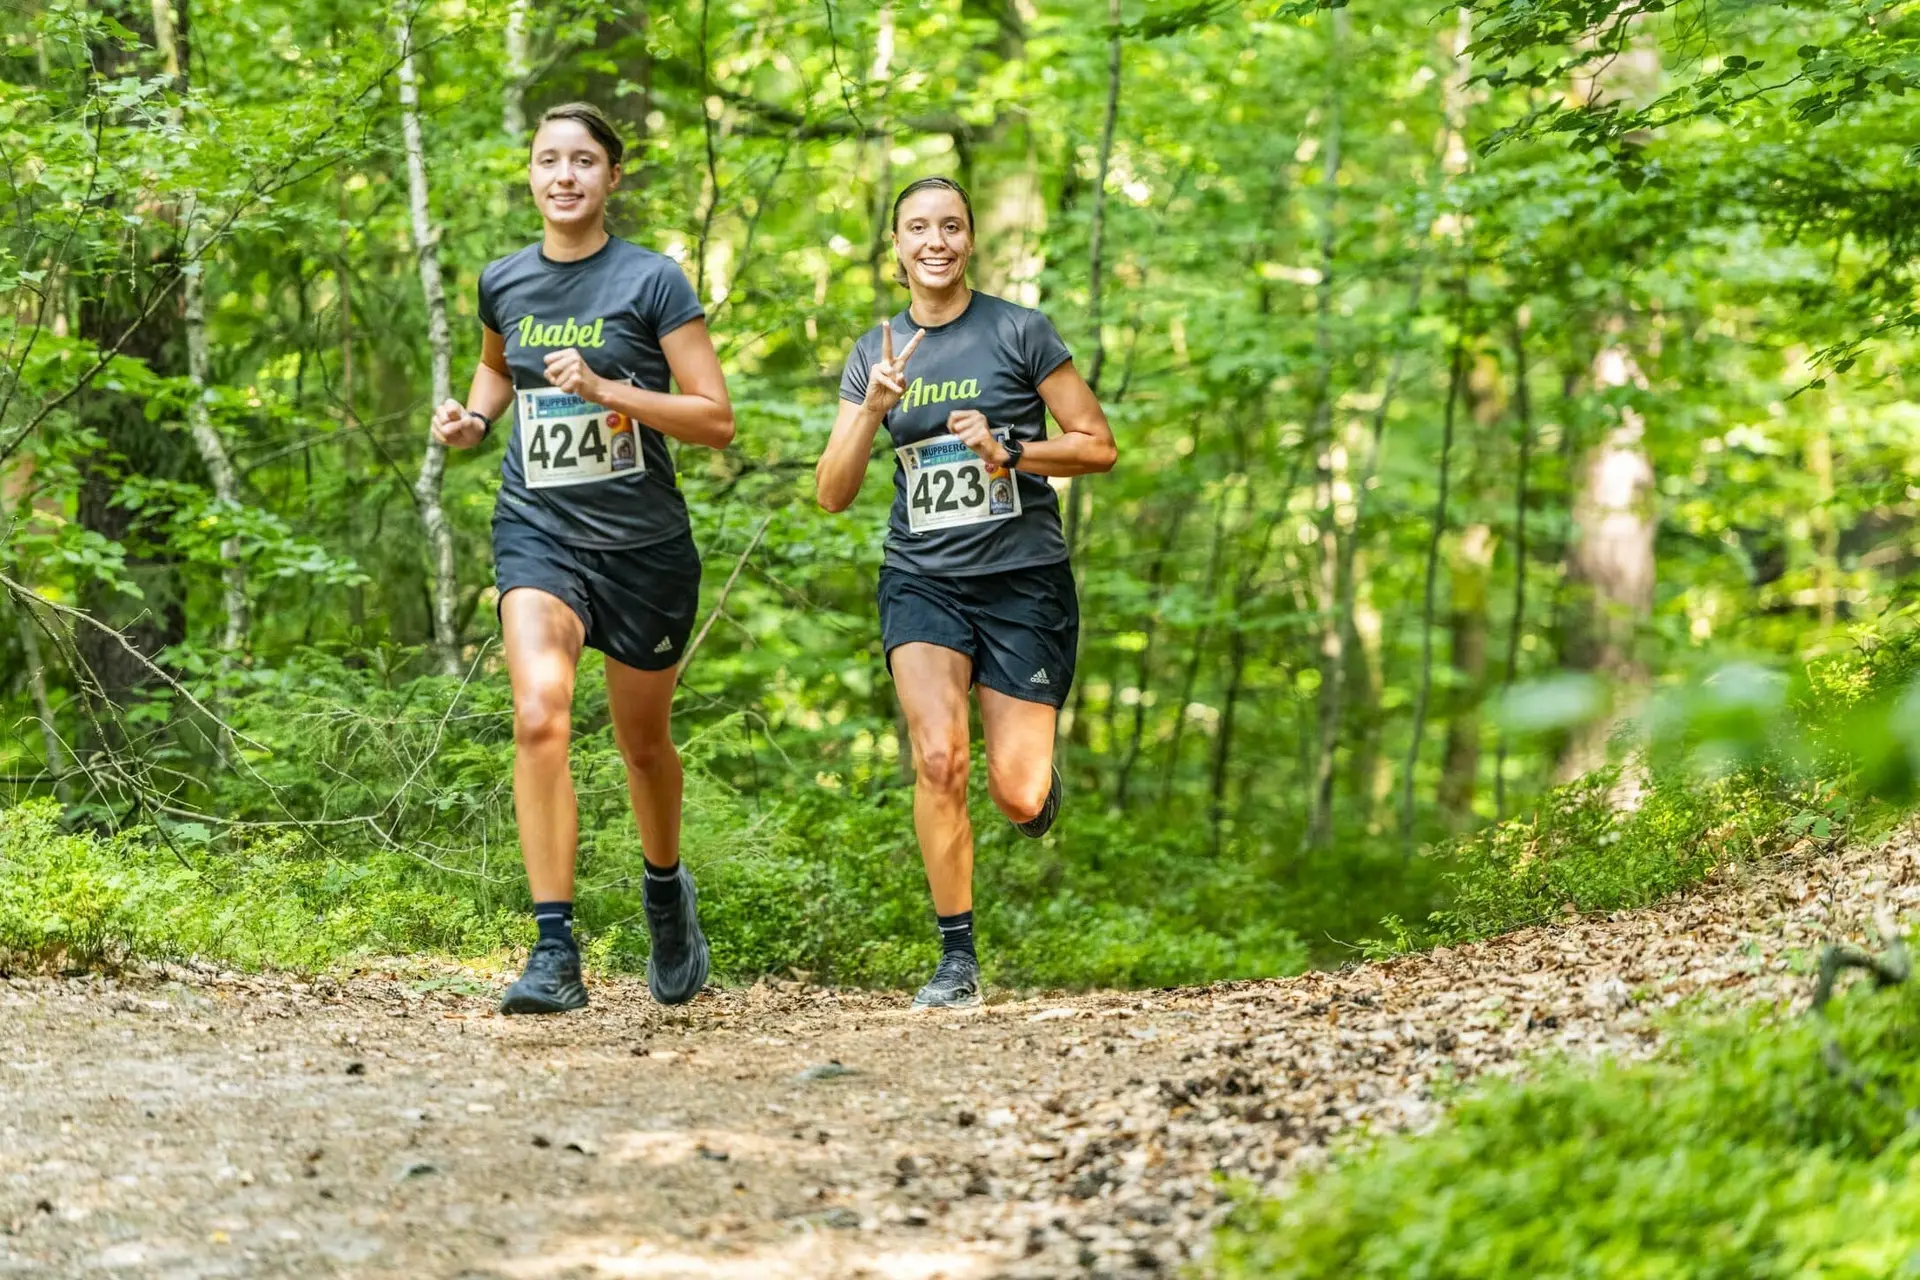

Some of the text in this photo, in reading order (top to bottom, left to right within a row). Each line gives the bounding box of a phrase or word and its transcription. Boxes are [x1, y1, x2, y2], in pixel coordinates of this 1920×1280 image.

[518, 315, 606, 348] Isabel
[900, 377, 982, 413] Anna
[528, 419, 608, 469] 424
[921, 442, 967, 457] MUPPBERG
[912, 465, 985, 514] 423
